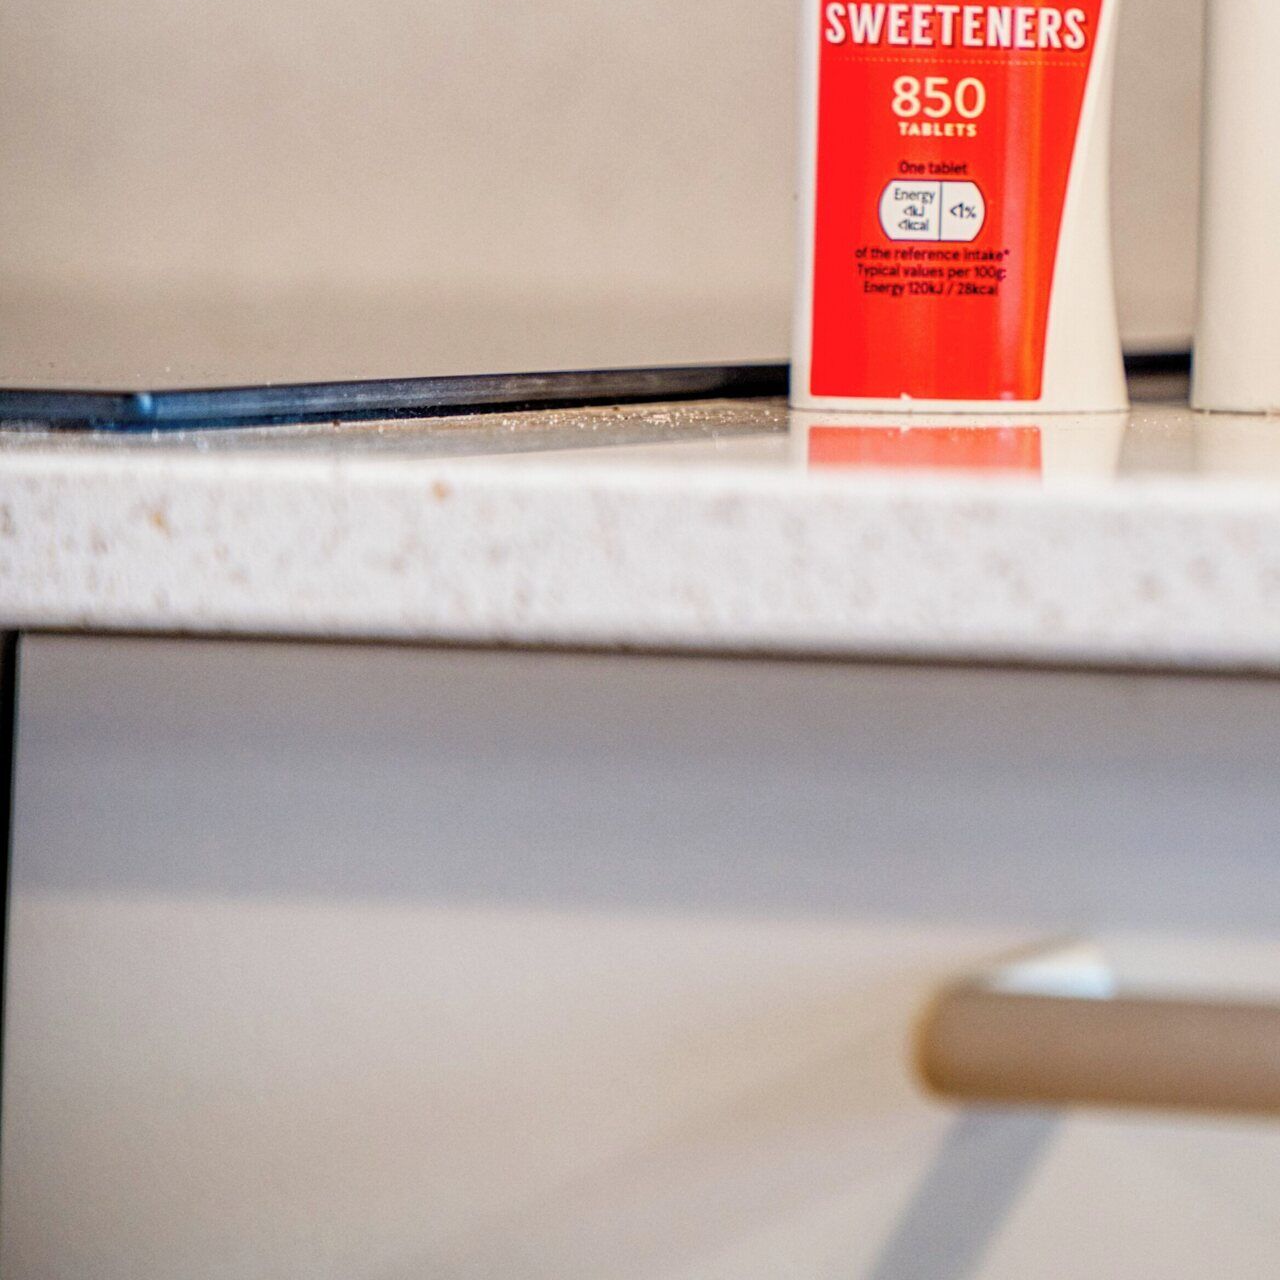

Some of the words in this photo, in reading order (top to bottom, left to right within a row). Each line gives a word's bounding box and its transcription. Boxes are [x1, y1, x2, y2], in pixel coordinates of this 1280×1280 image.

[825, 2, 1088, 50] SWEETENERS
[891, 76, 987, 119] 850
[898, 122, 977, 137] TABLETS
[899, 161, 926, 174] One
[929, 162, 968, 174] tablet
[894, 188, 935, 205] Energy
[950, 202, 977, 219] <1%
[855, 247, 867, 259] of
[870, 247, 890, 259] the
[894, 247, 960, 260] reference
[857, 265, 899, 277] Typical
[904, 265, 944, 277] values
[947, 268, 969, 279] per
[864, 281, 905, 296] Energy
[908, 282, 944, 294] 120kJ
[958, 283, 998, 295] 28kcal
